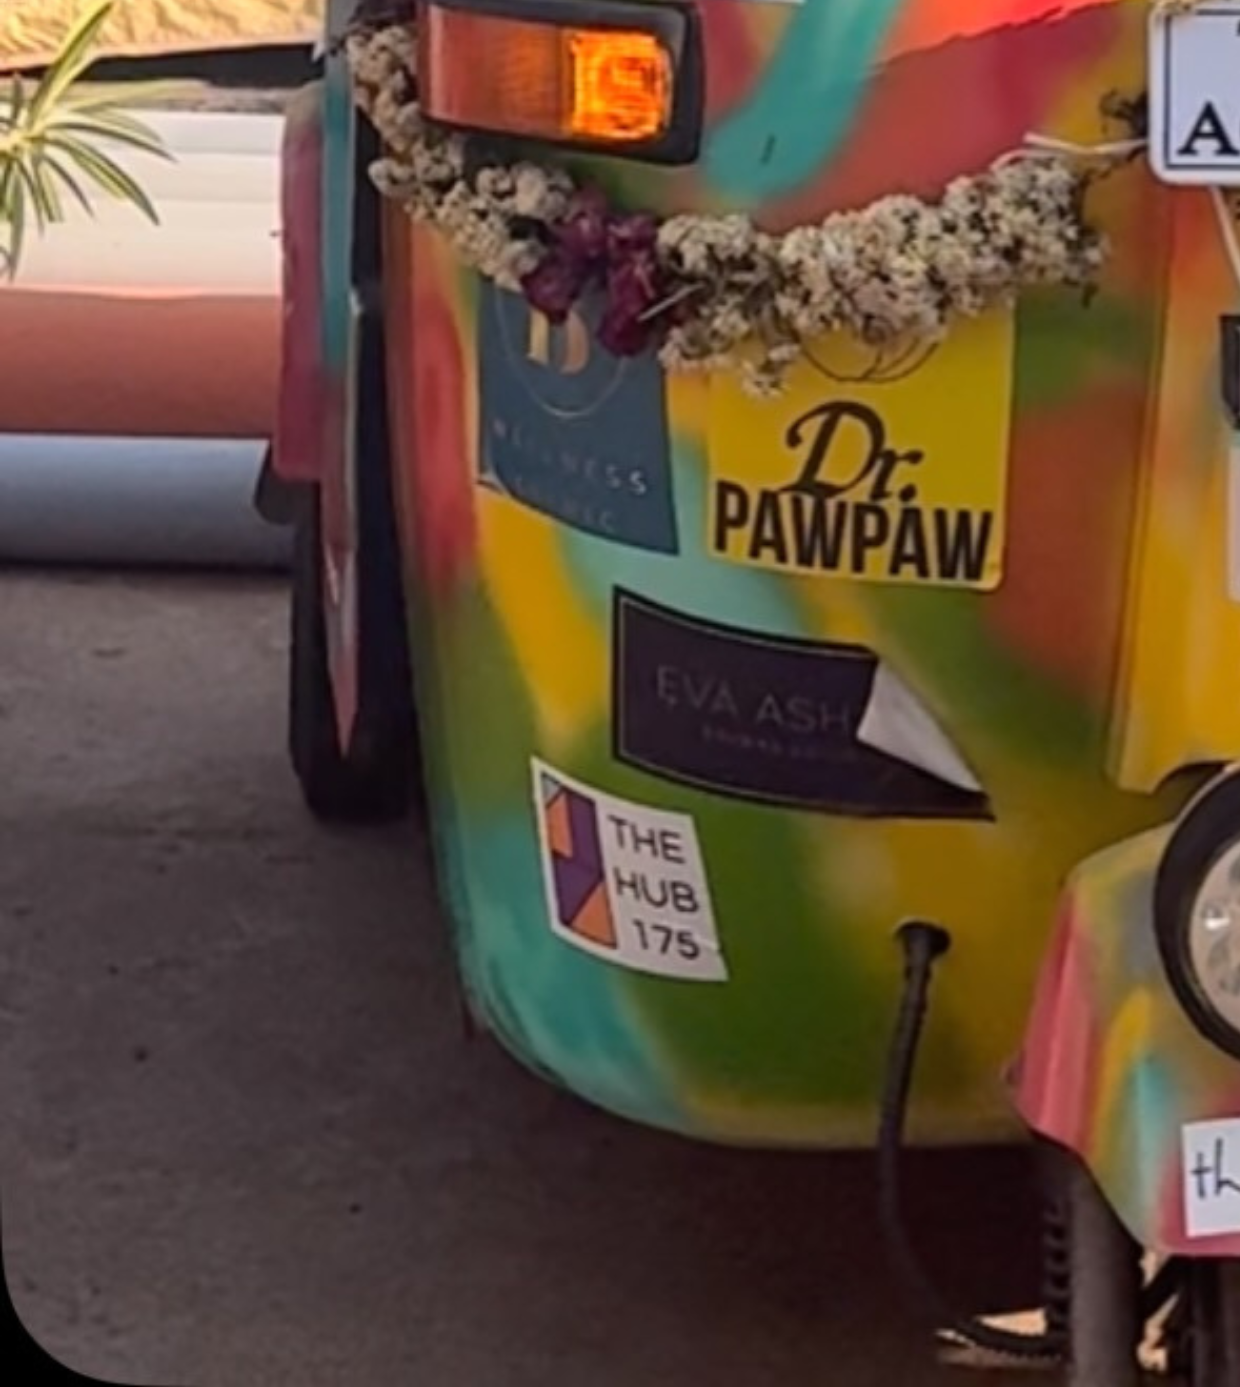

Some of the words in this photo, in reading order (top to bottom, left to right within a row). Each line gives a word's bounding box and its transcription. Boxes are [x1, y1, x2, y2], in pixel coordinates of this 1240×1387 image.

[785, 400, 924, 504] Dr.
[714, 481, 994, 581] PAWPAW
[656, 662, 740, 718] EVA
[606, 814, 687, 864] THE
[614, 867, 700, 913] HUB
[631, 920, 701, 960] 175
